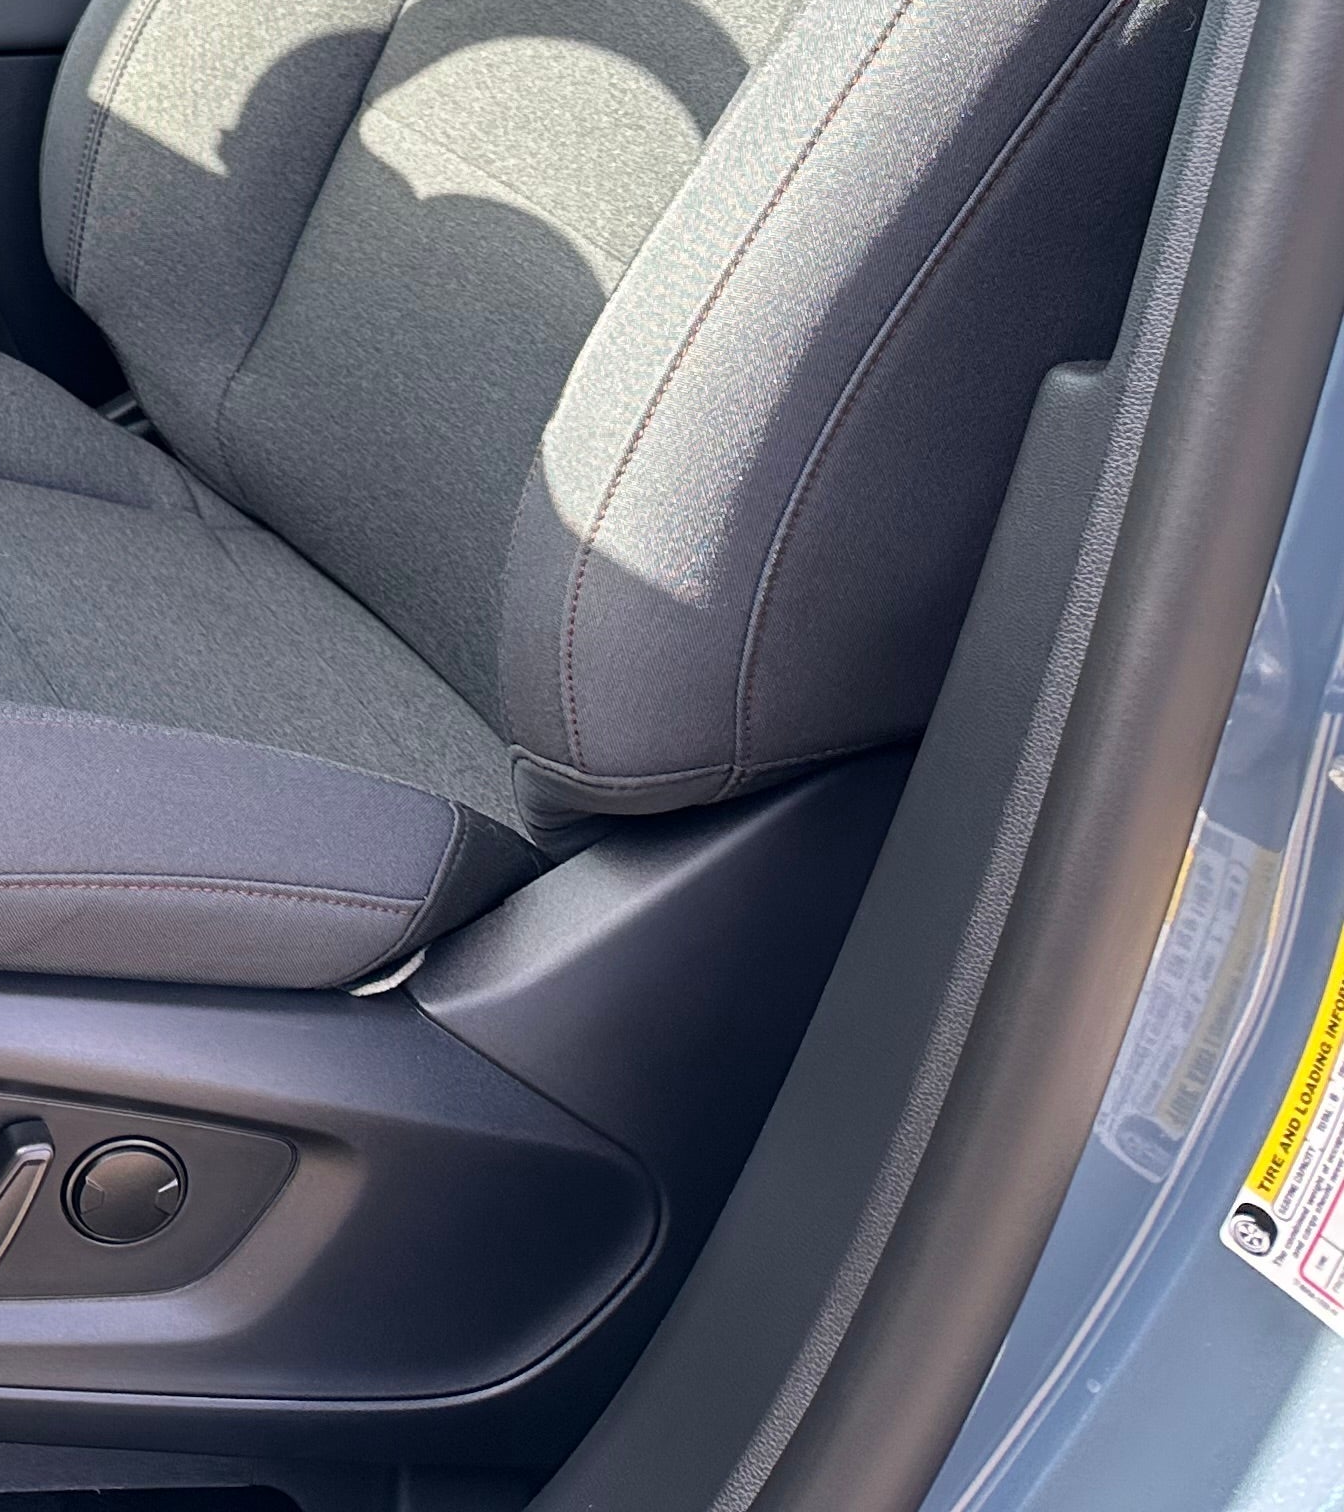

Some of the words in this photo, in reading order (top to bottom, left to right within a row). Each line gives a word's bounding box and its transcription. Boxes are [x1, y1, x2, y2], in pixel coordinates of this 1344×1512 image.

[1257, 1153, 1286, 1193] TIRE
[1279, 1117, 1302, 1155] AND
[1294, 1041, 1333, 1116] LOADING
